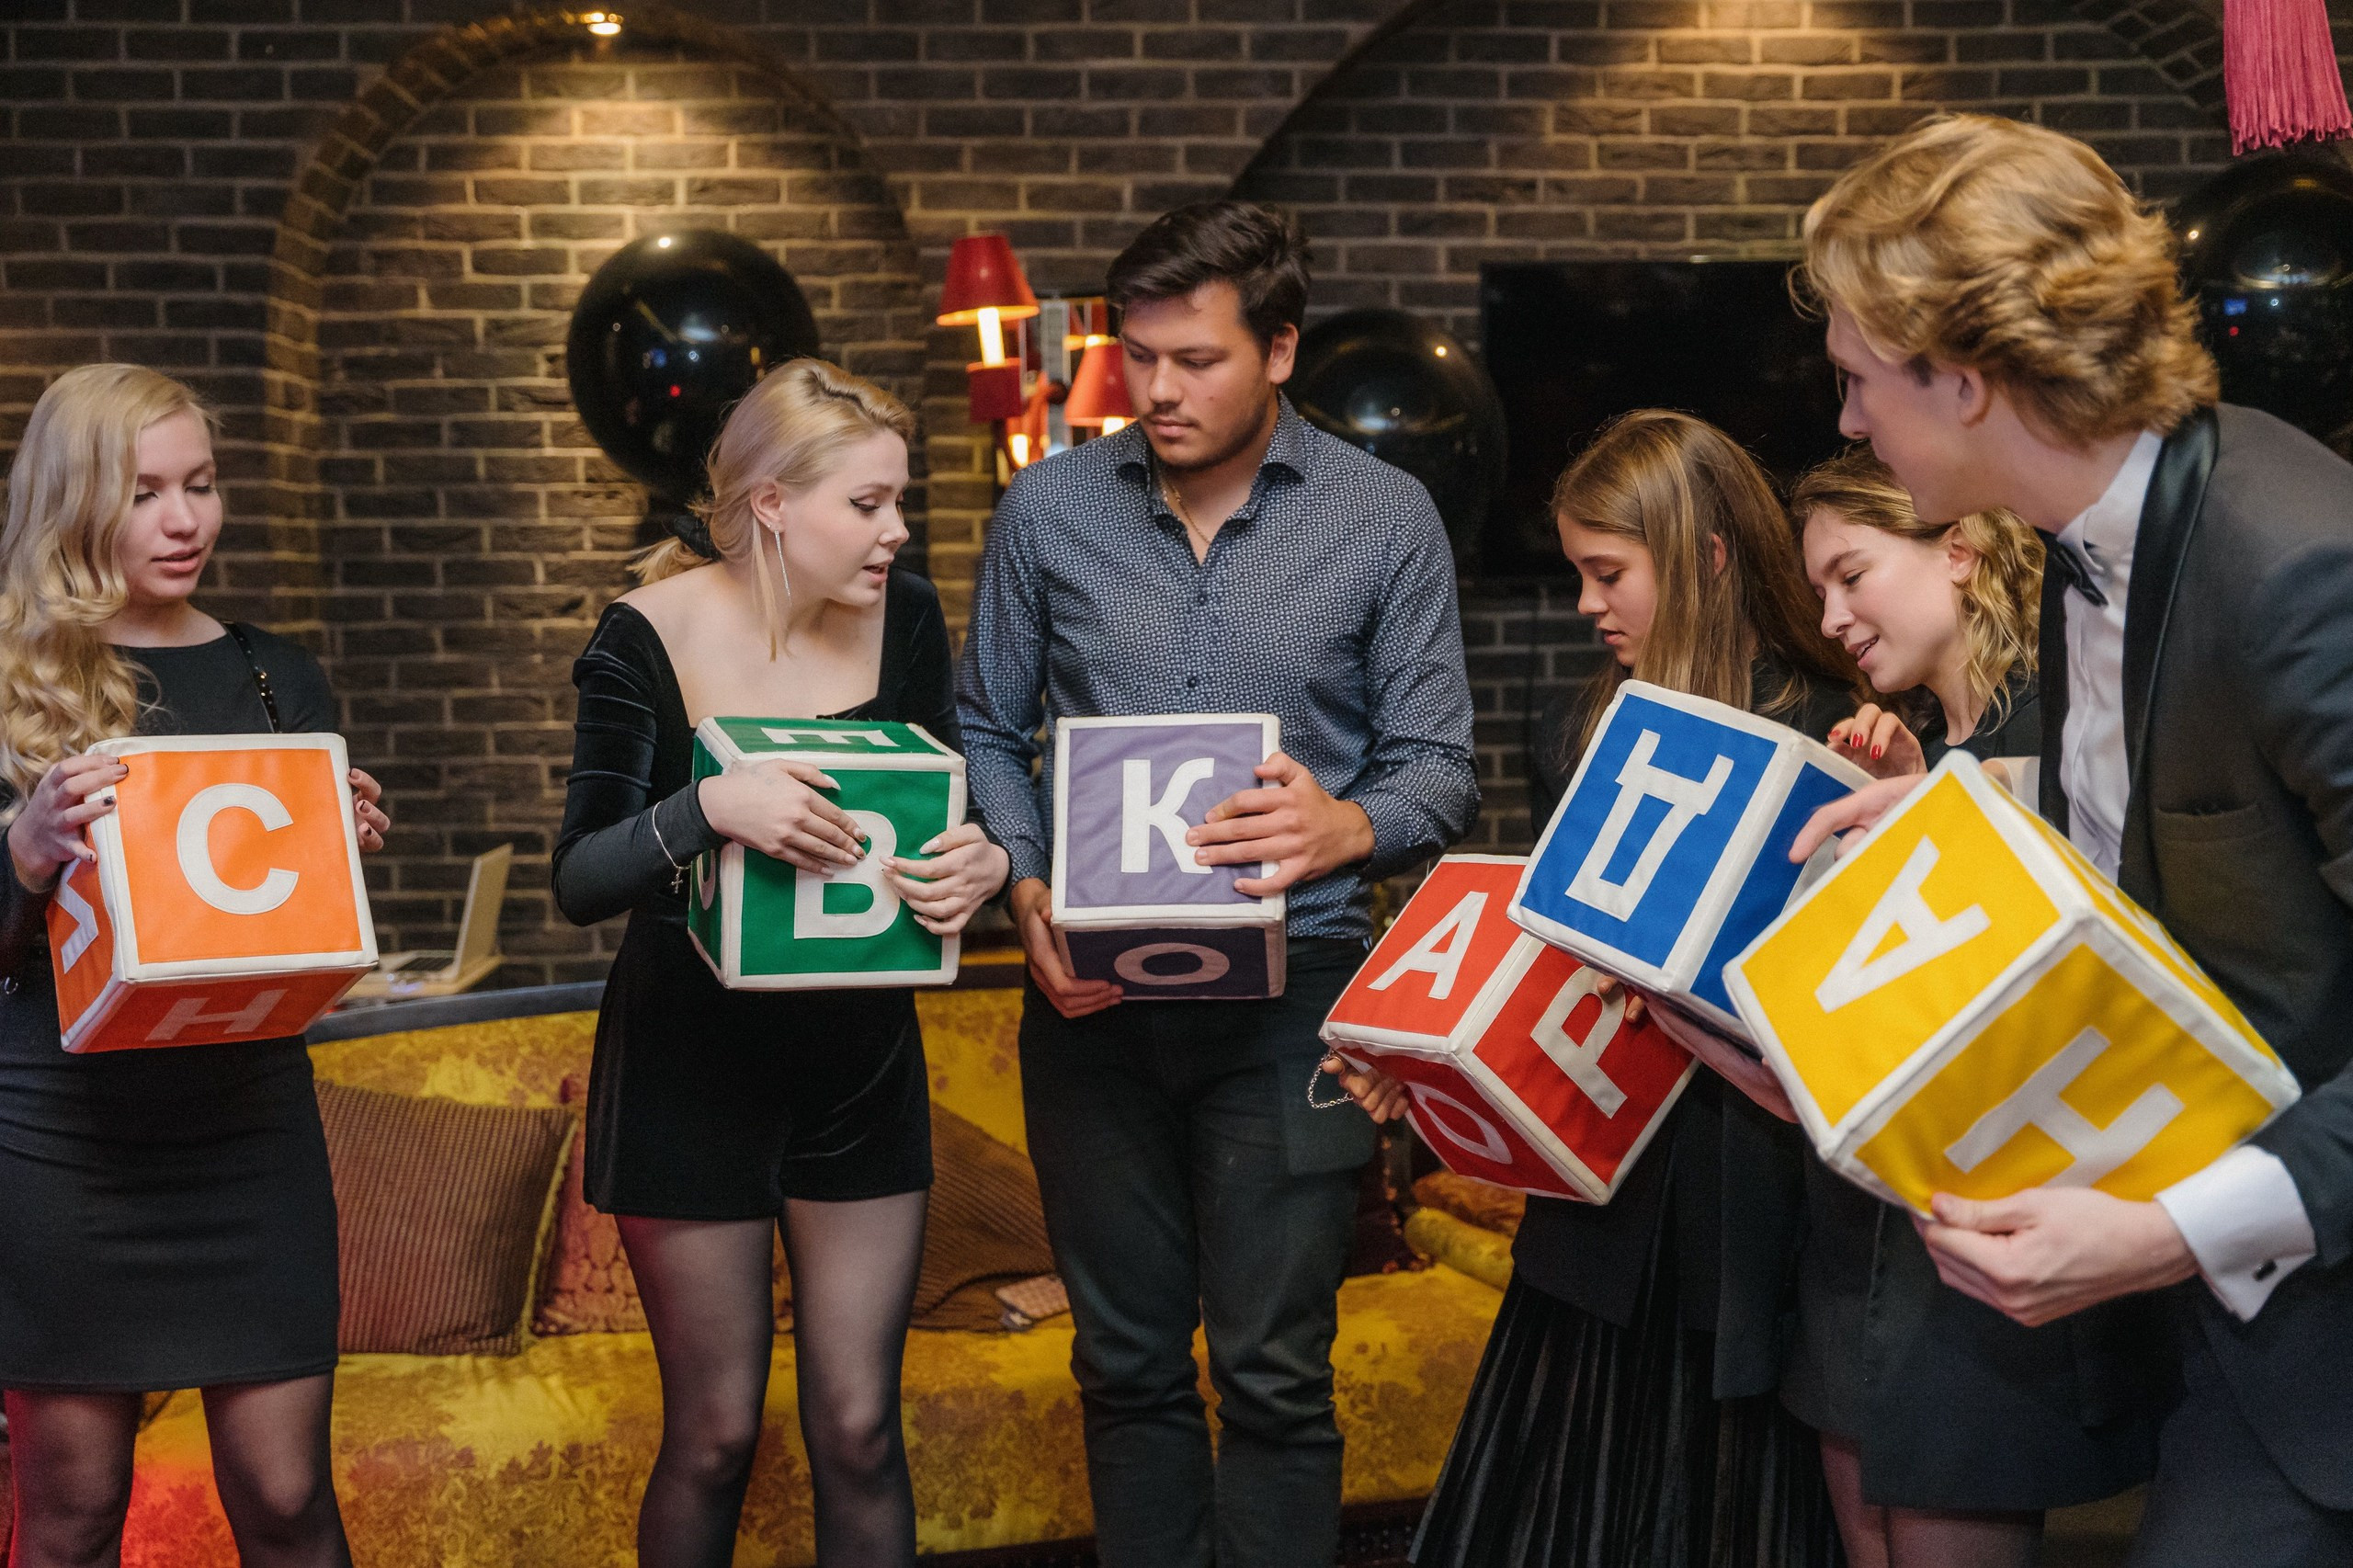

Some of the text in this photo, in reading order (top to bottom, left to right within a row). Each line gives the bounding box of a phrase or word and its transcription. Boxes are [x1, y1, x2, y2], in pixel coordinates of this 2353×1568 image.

[176, 783, 299, 915] С
[794, 810, 901, 939] В
[1120, 757, 1214, 874] К
[1565, 729, 1733, 921] Д
[1113, 942, 1231, 985] О
[1367, 891, 1489, 999] А
[1814, 834, 1992, 1014] А
[144, 989, 288, 1041] Н
[1530, 965, 1629, 1119] Р
